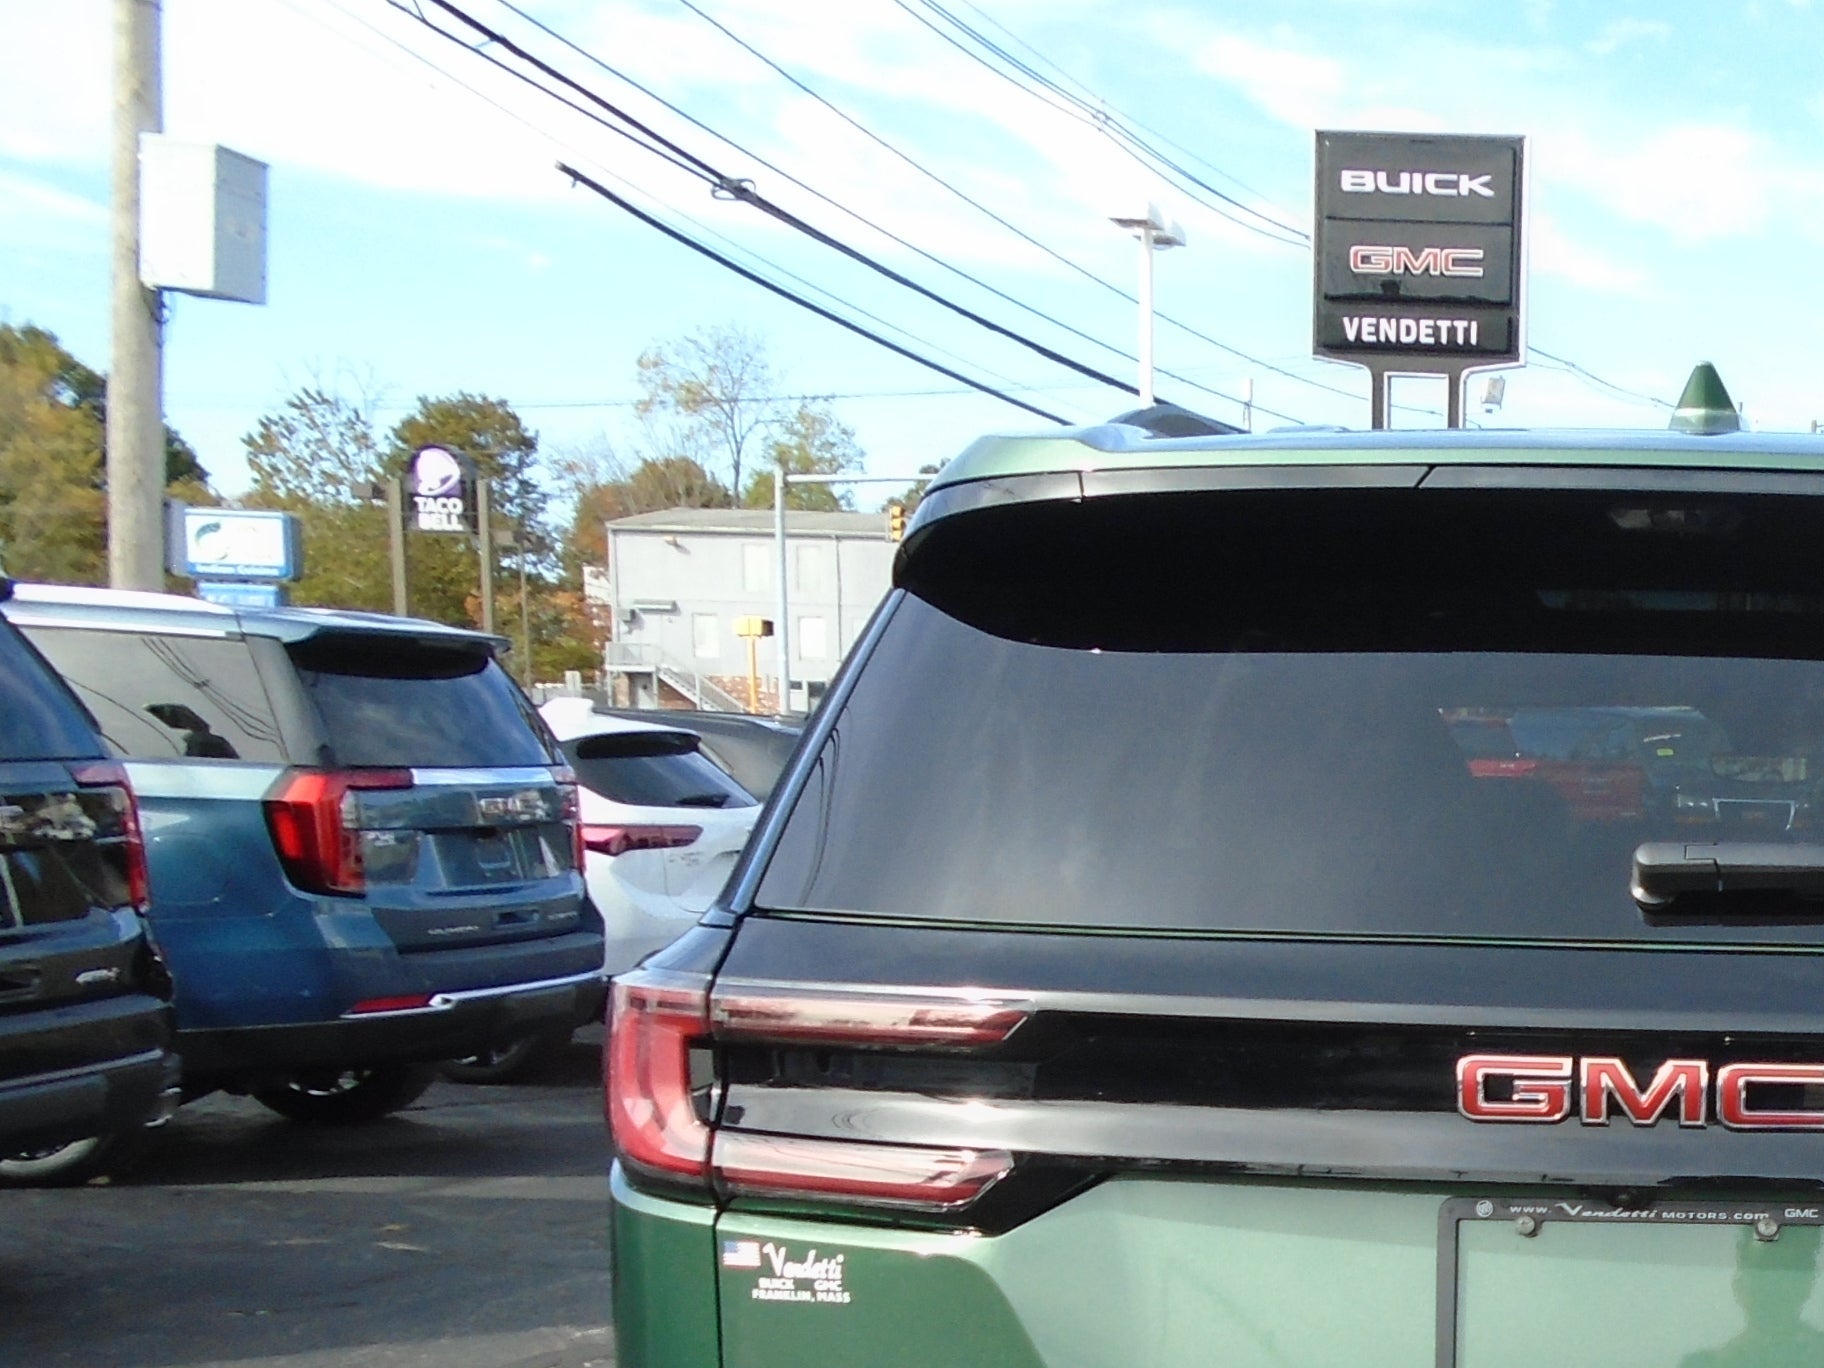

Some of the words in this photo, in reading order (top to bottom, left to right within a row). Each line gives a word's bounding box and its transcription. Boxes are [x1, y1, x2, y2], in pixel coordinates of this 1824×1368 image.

[1340, 169, 1495, 198] BUICK
[1349, 245, 1484, 278] GMC
[1342, 316, 1478, 346] VENDETTI
[413, 496, 464, 515] TACO
[418, 512, 464, 531] BELL
[1554, 1201, 1658, 1218] Vendetti
[1784, 1207, 1819, 1219] GMC
[762, 1241, 845, 1280] Vendetti
[758, 1277, 795, 1290] BUICK
[814, 1279, 843, 1292] GMC
[816, 1290, 851, 1304] MASS
